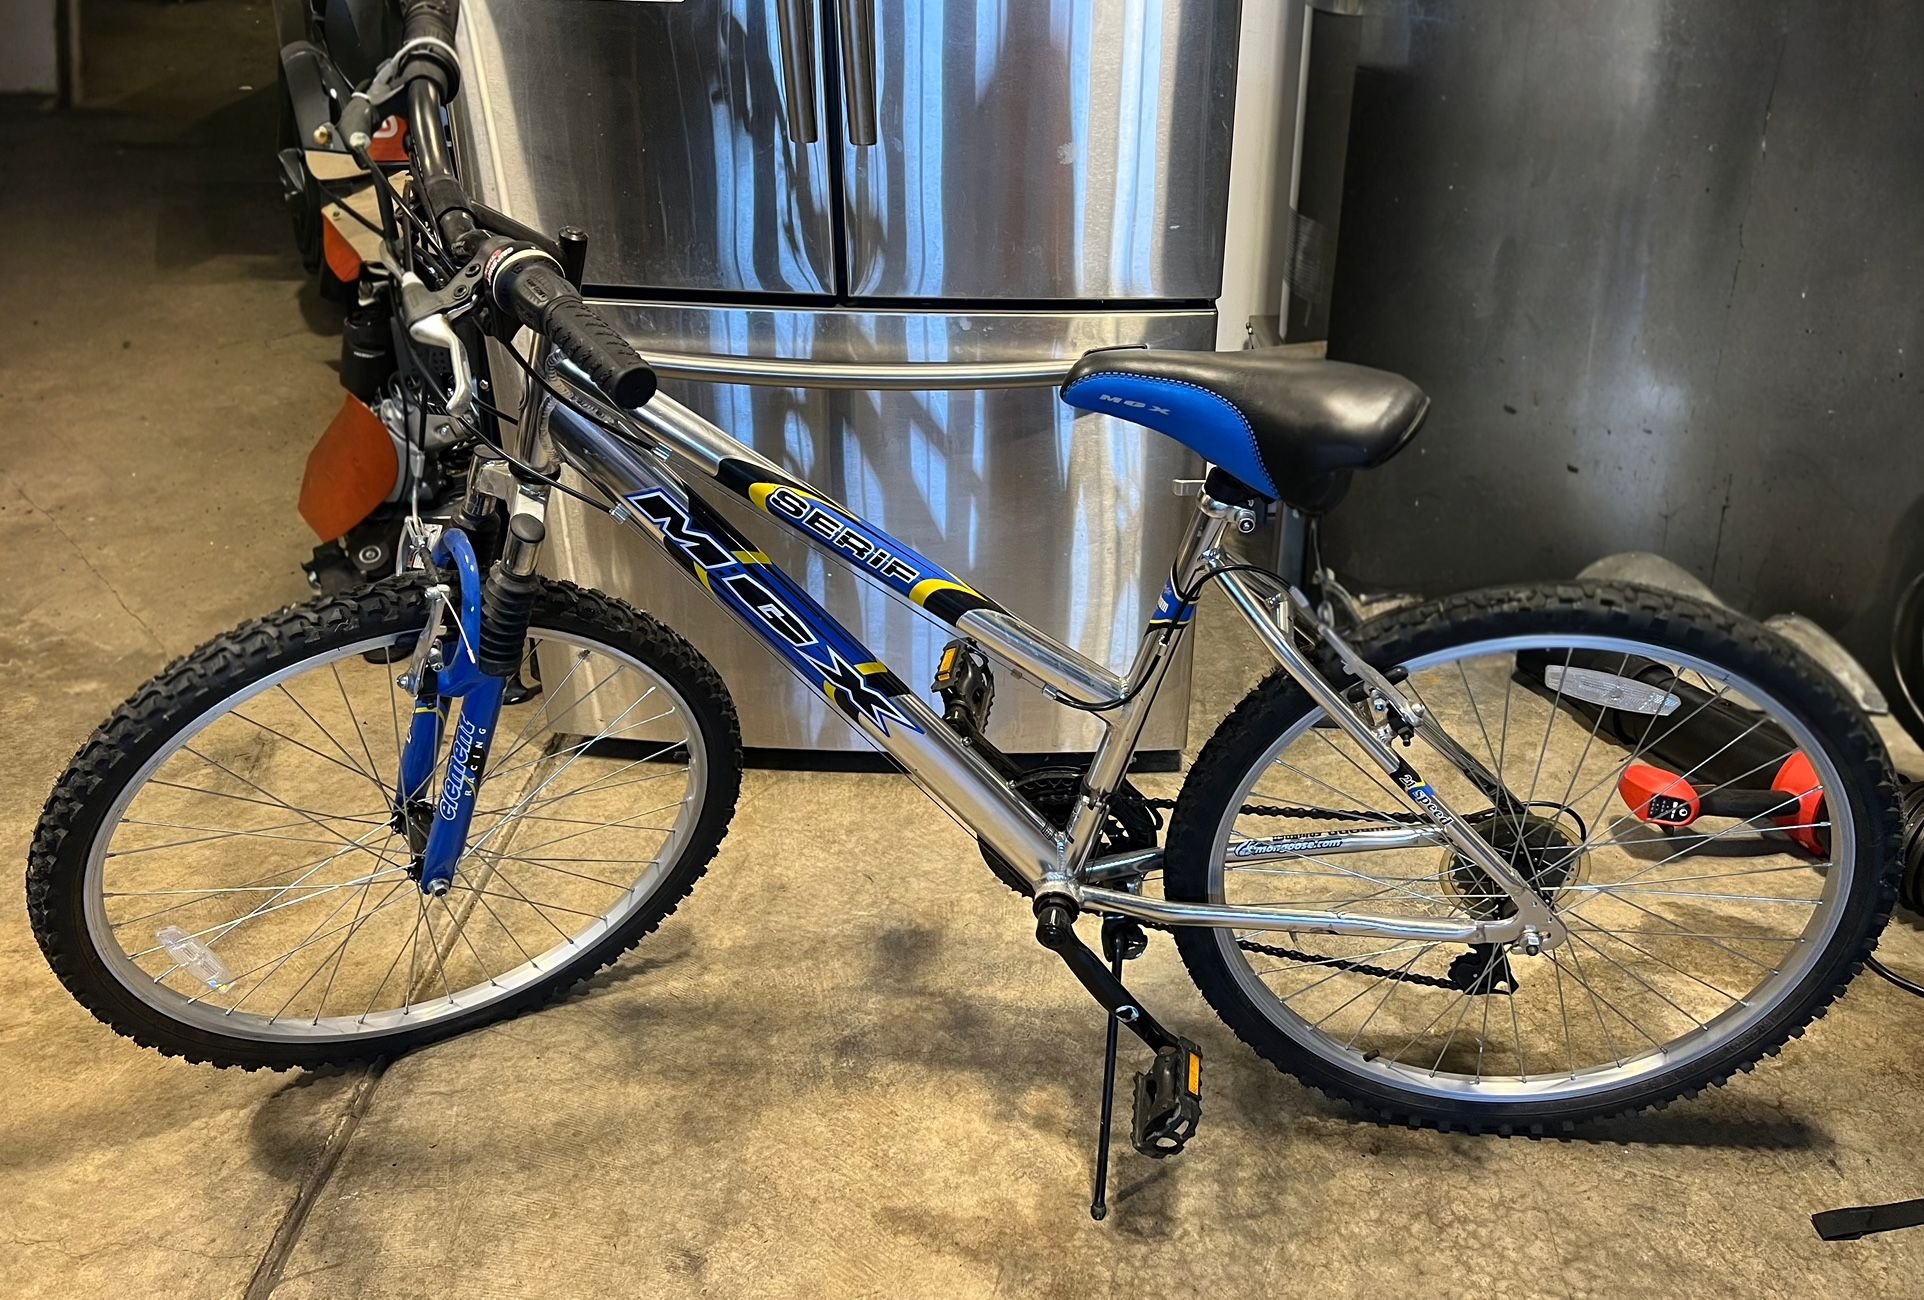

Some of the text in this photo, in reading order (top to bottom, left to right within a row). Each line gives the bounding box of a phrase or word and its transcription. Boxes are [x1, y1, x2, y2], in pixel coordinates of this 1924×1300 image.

[1098, 394, 1171, 416] MGX
[768, 486, 921, 585] SERIF
[624, 490, 919, 735] MGX
[464, 727, 487, 797] RACING
[1398, 774, 1455, 826] 21 speed
